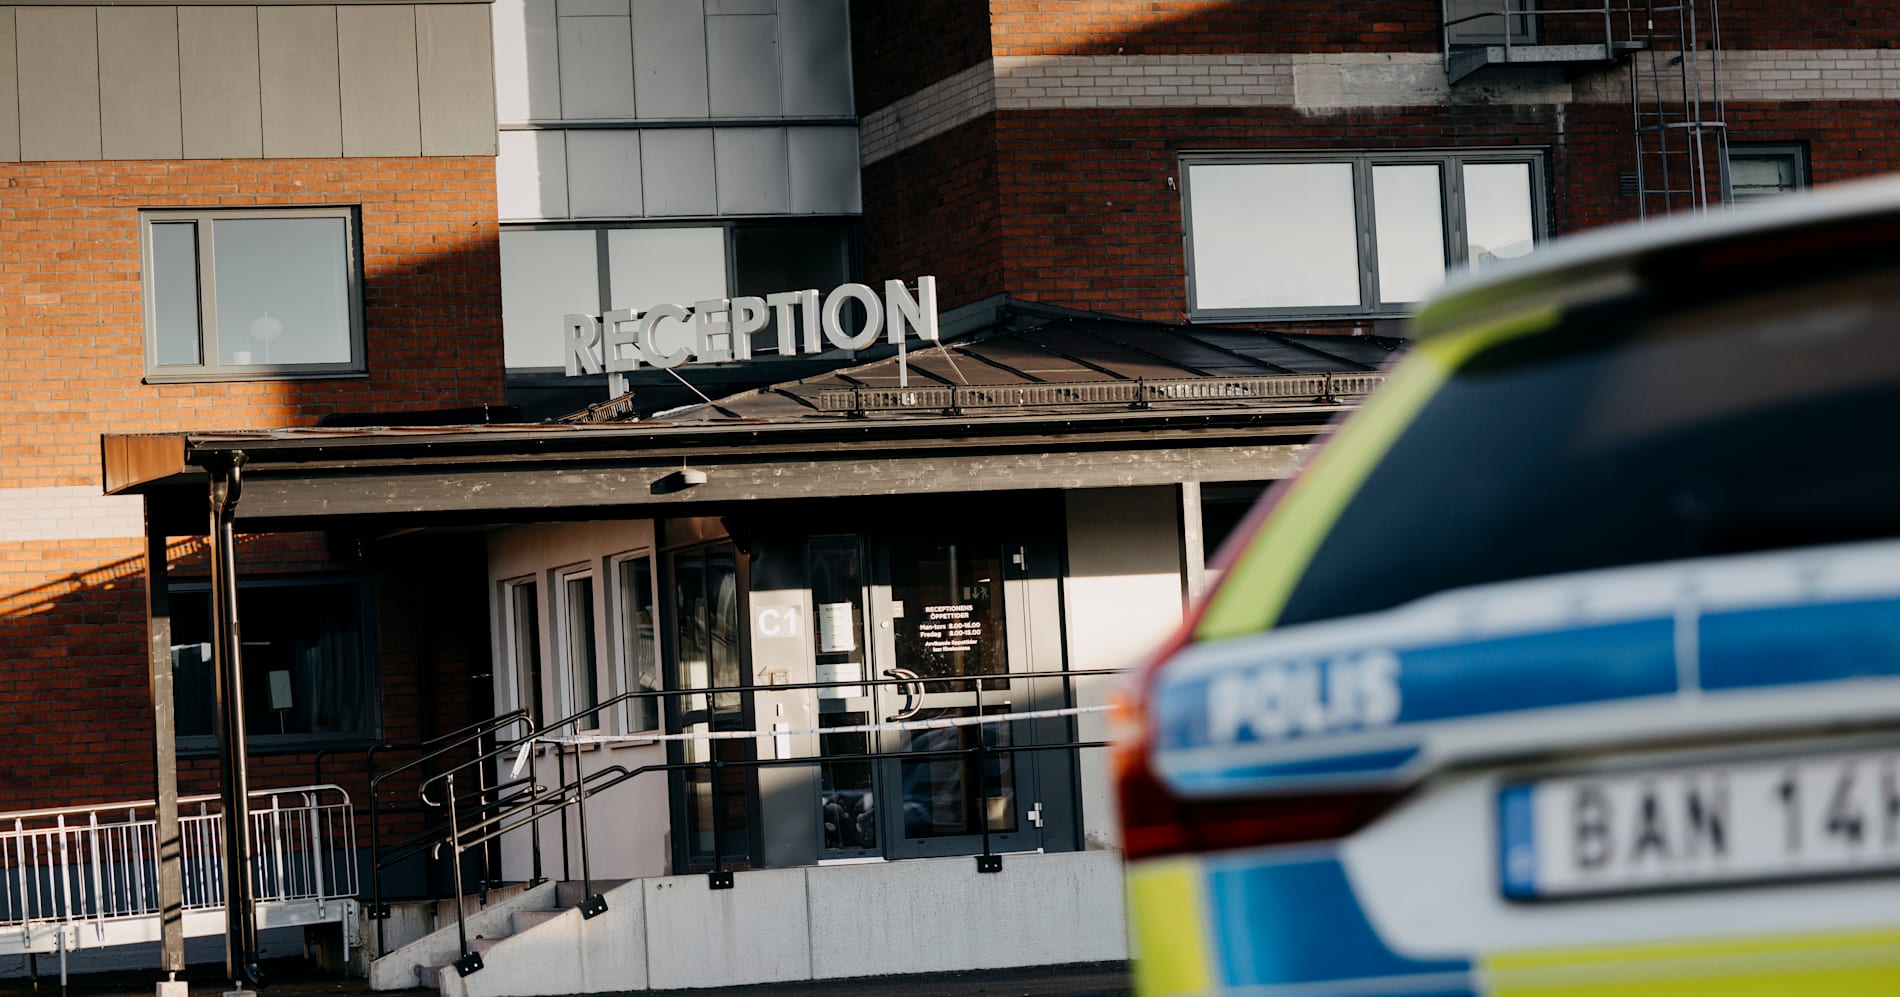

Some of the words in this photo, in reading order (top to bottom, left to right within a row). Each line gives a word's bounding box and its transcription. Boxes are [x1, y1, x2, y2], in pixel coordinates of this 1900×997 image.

[564, 275, 939, 377] RECEPTION
[758, 607, 797, 636] C1
[925, 604, 973, 613] RECEPTIONENS
[930, 612, 969, 620] ÖPPETTIDER
[1205, 648, 1402, 743] POLIS
[1574, 778, 1729, 873] BAN
